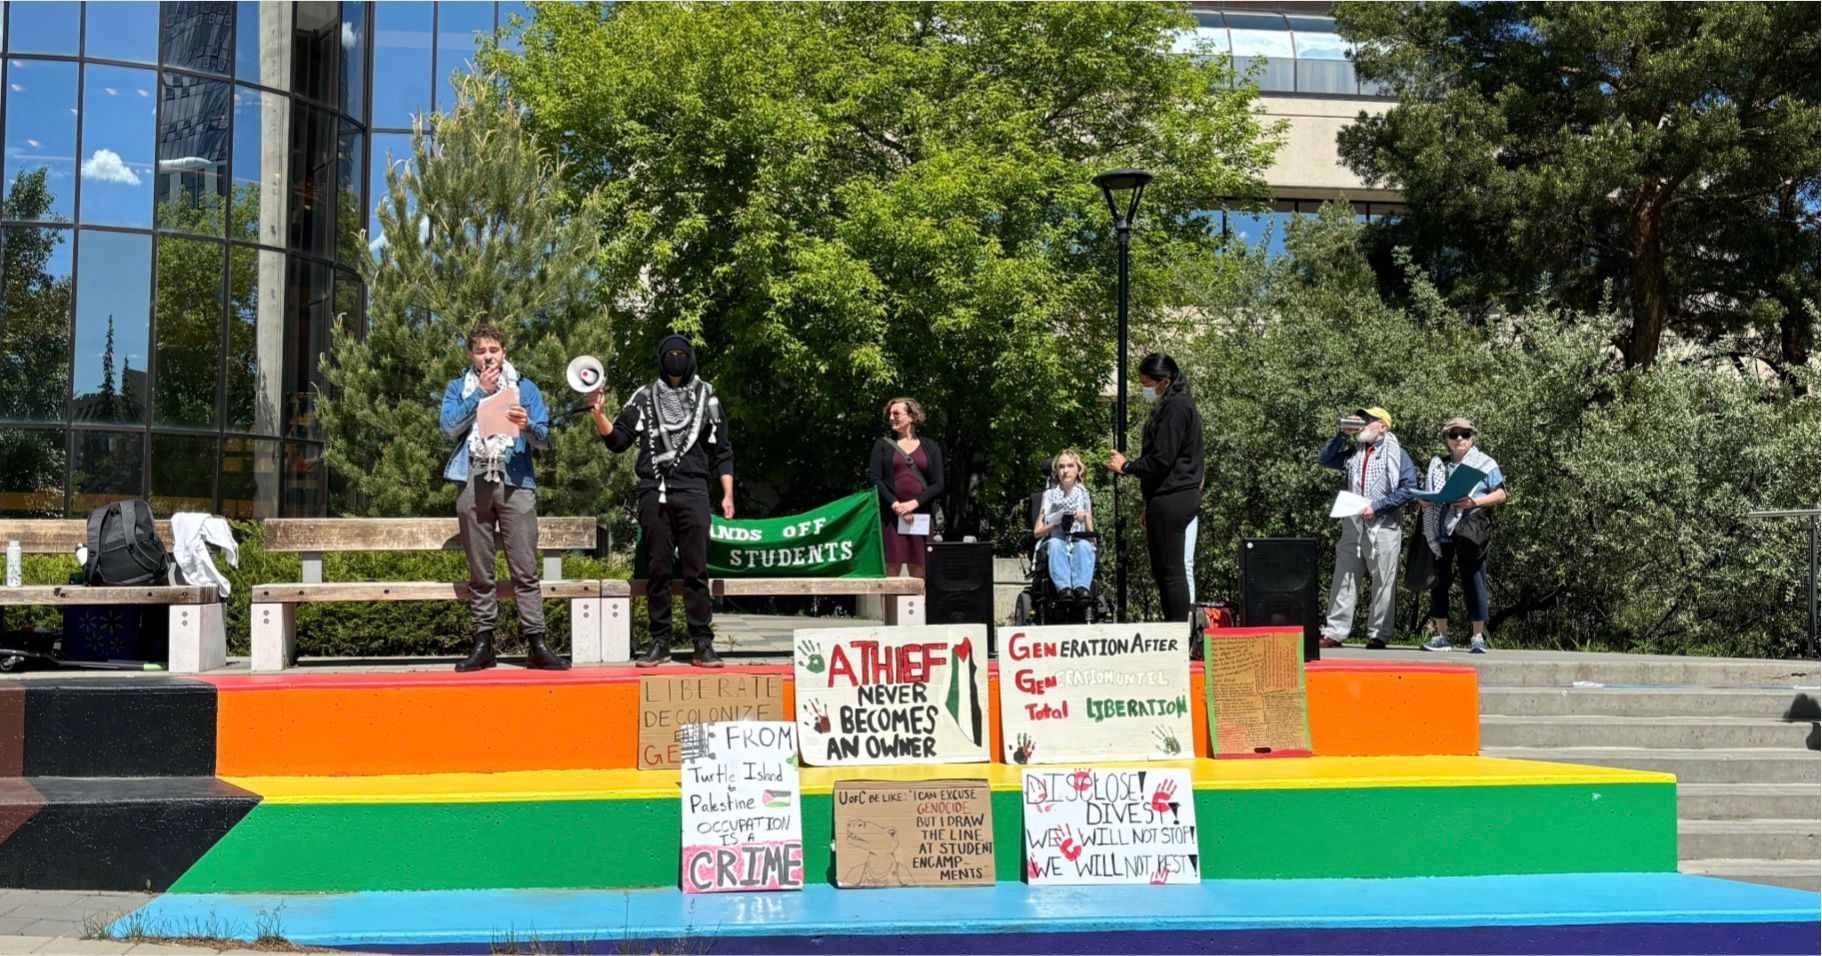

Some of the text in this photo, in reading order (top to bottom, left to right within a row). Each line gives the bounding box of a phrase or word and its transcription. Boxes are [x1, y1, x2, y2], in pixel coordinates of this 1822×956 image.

[783, 518, 826, 538] OFF
[730, 540, 853, 568] STUDENTS
[827, 640, 948, 688] A THIEF
[645, 677, 780, 702] LIBERATE
[1116, 671, 1169, 686] UNTIL
[858, 683, 928, 707] NEVER
[644, 704, 770, 728] DECOLONIZE
[840, 705, 940, 735] BECOMES
[1086, 695, 1187, 723] LIBERATION
[726, 725, 793, 750] FROM
[827, 734, 937, 761] AN OWNER
[688, 764, 736, 783] Turtle
[690, 792, 756, 814] Palestine
[918, 791, 937, 800] CAN
[940, 788, 977, 801] EXCUSE
[916, 801, 971, 814] GENOCIDE
[1086, 801, 1181, 826] DIVEST!
[697, 814, 791, 834] OCCUPATION
[916, 813, 985, 828] BUT I DRAW
[719, 833, 755, 846] IS A
[921, 828, 984, 841] THE LINE
[1026, 825, 1195, 849] WE WILL NOT STOP!
[919, 841, 993, 855] AT STUDENT
[689, 843, 803, 889] CRIME
[1030, 856, 1063, 878] WE
[1073, 852, 1123, 878] WILL
[1124, 854, 1152, 879] NOT
